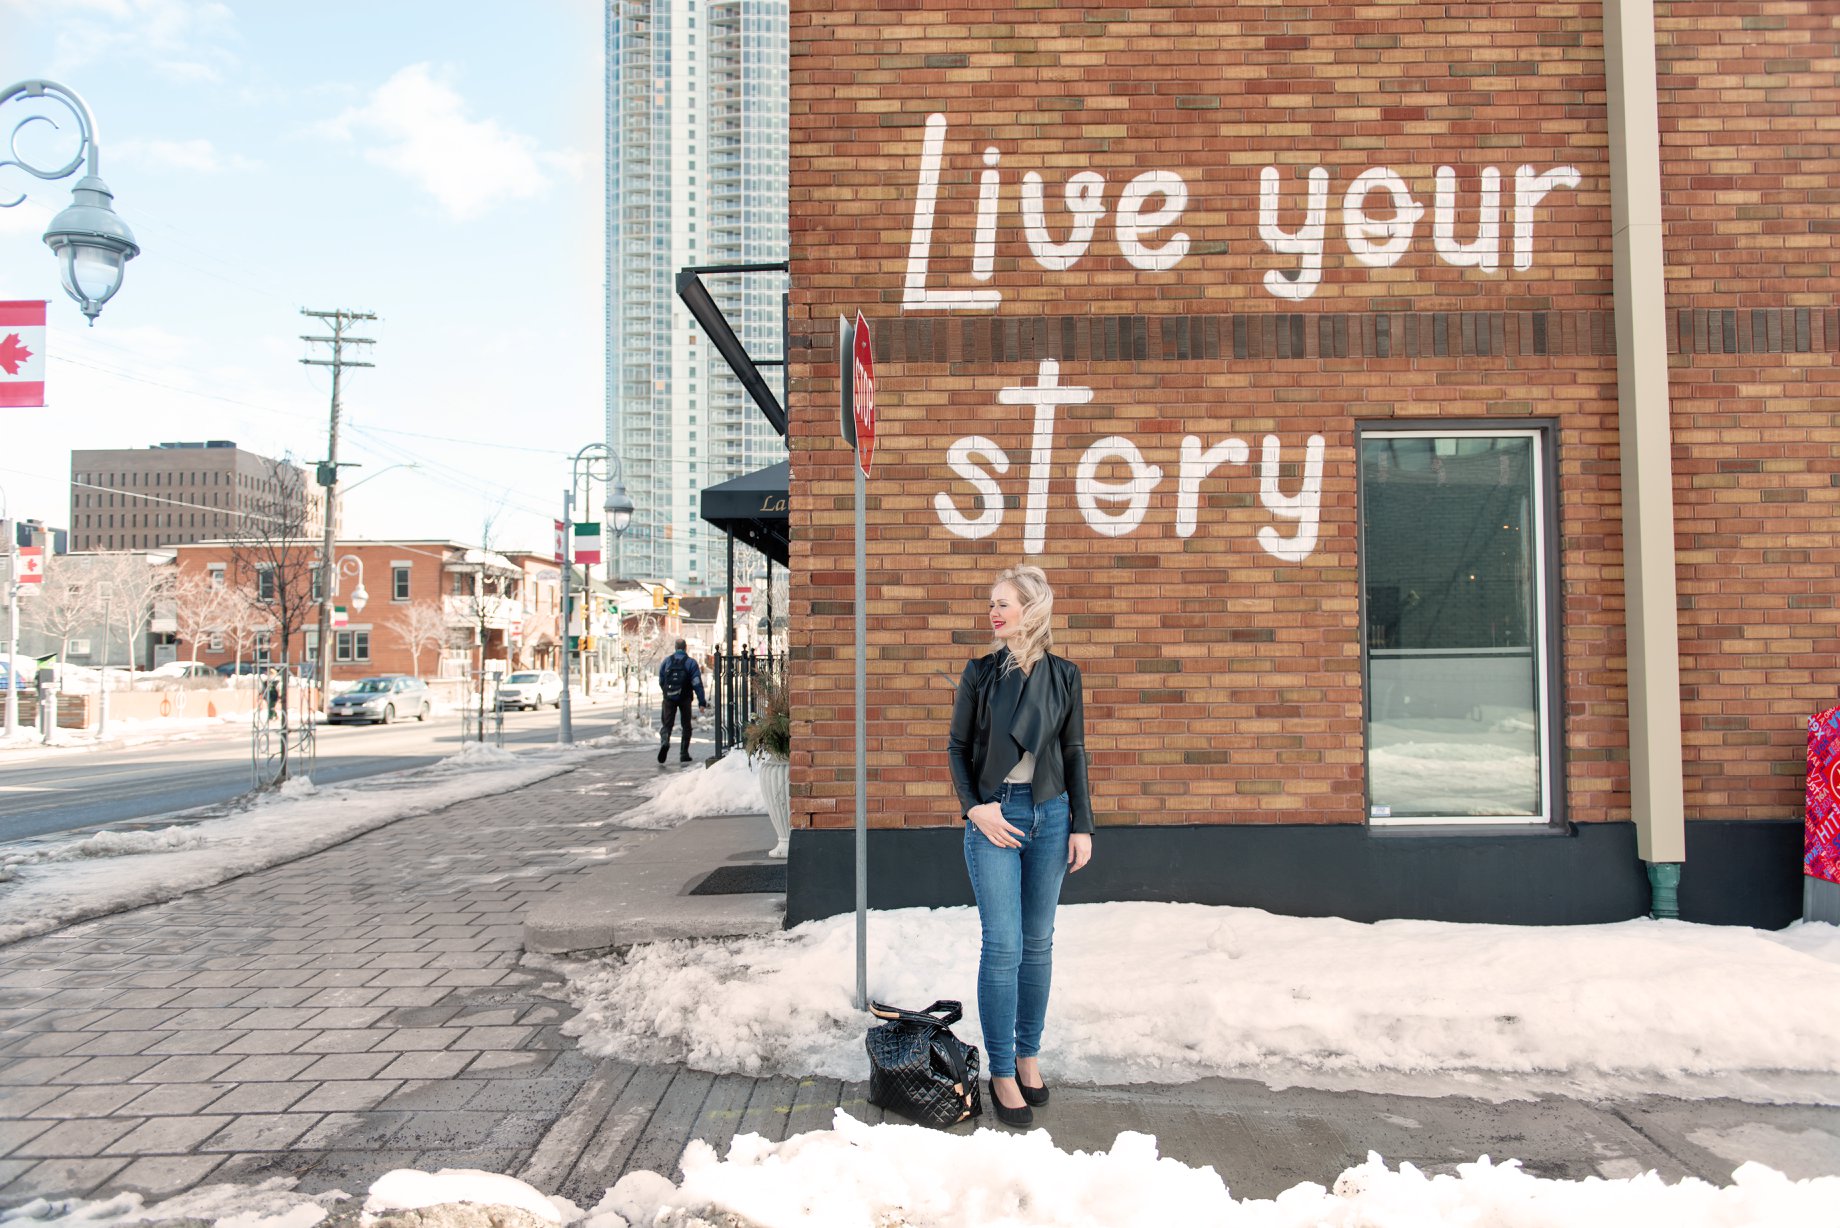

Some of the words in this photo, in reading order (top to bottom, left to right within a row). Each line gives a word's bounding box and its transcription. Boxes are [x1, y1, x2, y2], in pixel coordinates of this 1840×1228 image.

[900, 113, 1191, 310] Live
[1258, 164, 1582, 302] your
[856, 356, 874, 431] STOP
[934, 357, 1326, 562] story
[760, 495, 787, 512] La
[1816, 811, 1840, 844] H1T
